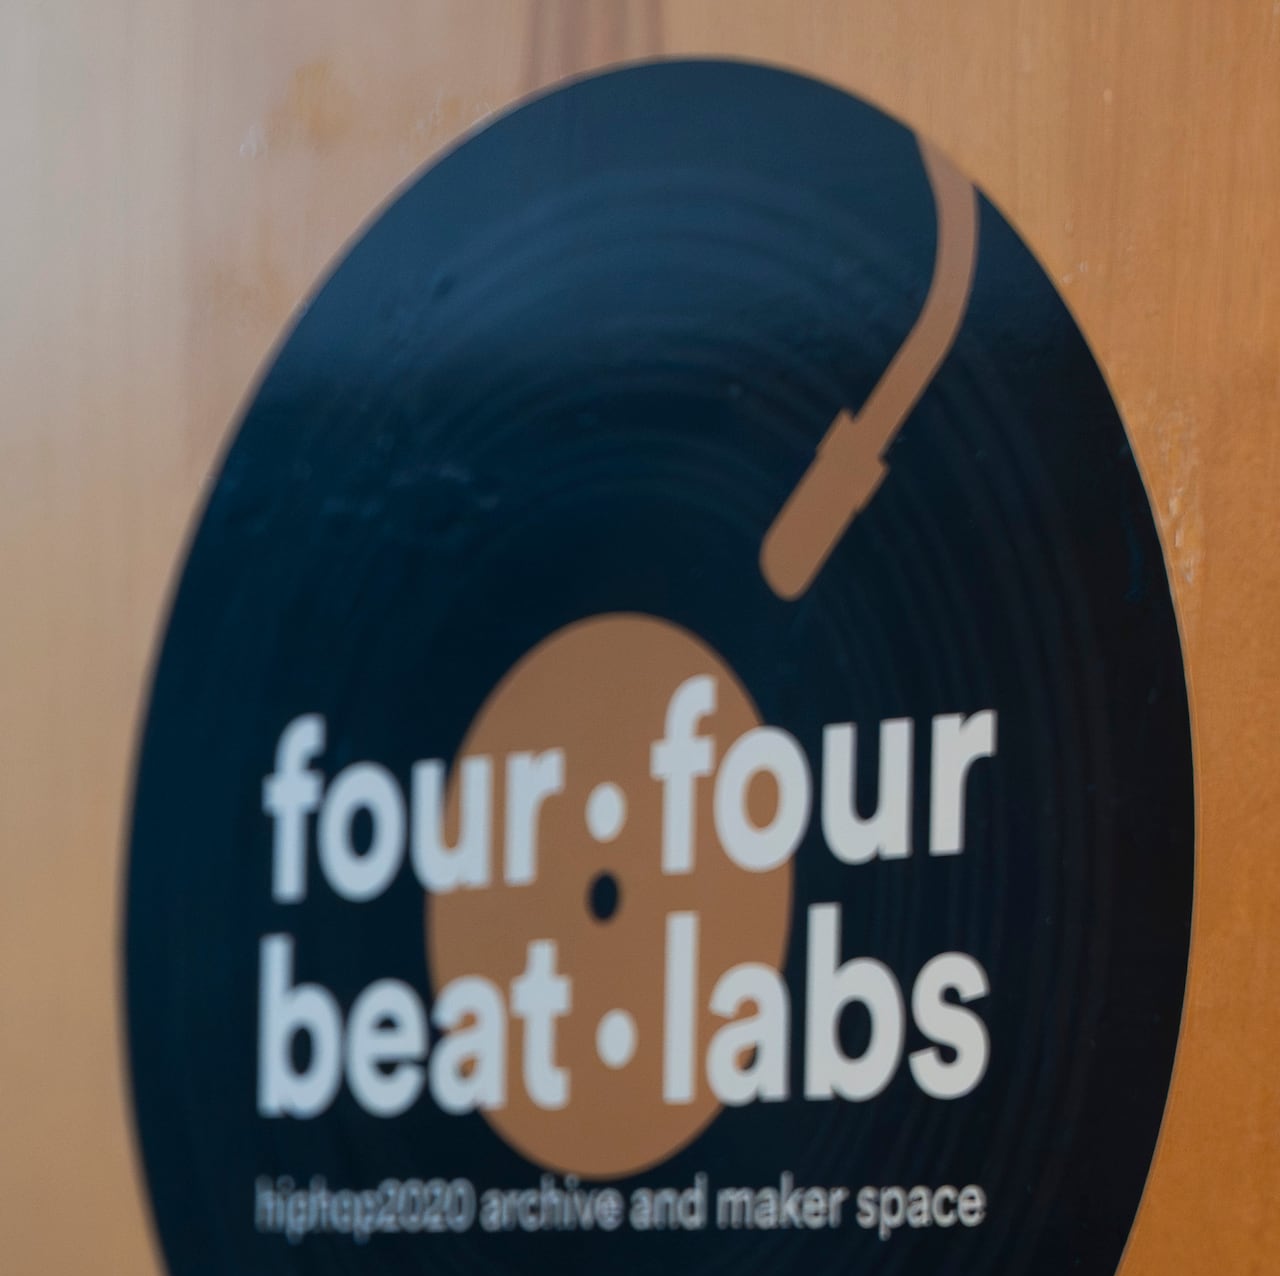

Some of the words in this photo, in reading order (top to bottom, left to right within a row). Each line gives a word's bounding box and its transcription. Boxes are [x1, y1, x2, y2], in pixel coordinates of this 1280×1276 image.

[264, 713, 565, 904] four
[651, 674, 997, 875] four
[257, 933, 572, 1118] beat
[662, 902, 990, 1107] labs
[254, 1174, 477, 1246] hiphop2020
[479, 1173, 624, 1232] archive
[629, 1171, 708, 1231] and
[716, 1170, 850, 1229] maker
[855, 1184, 987, 1241] space
